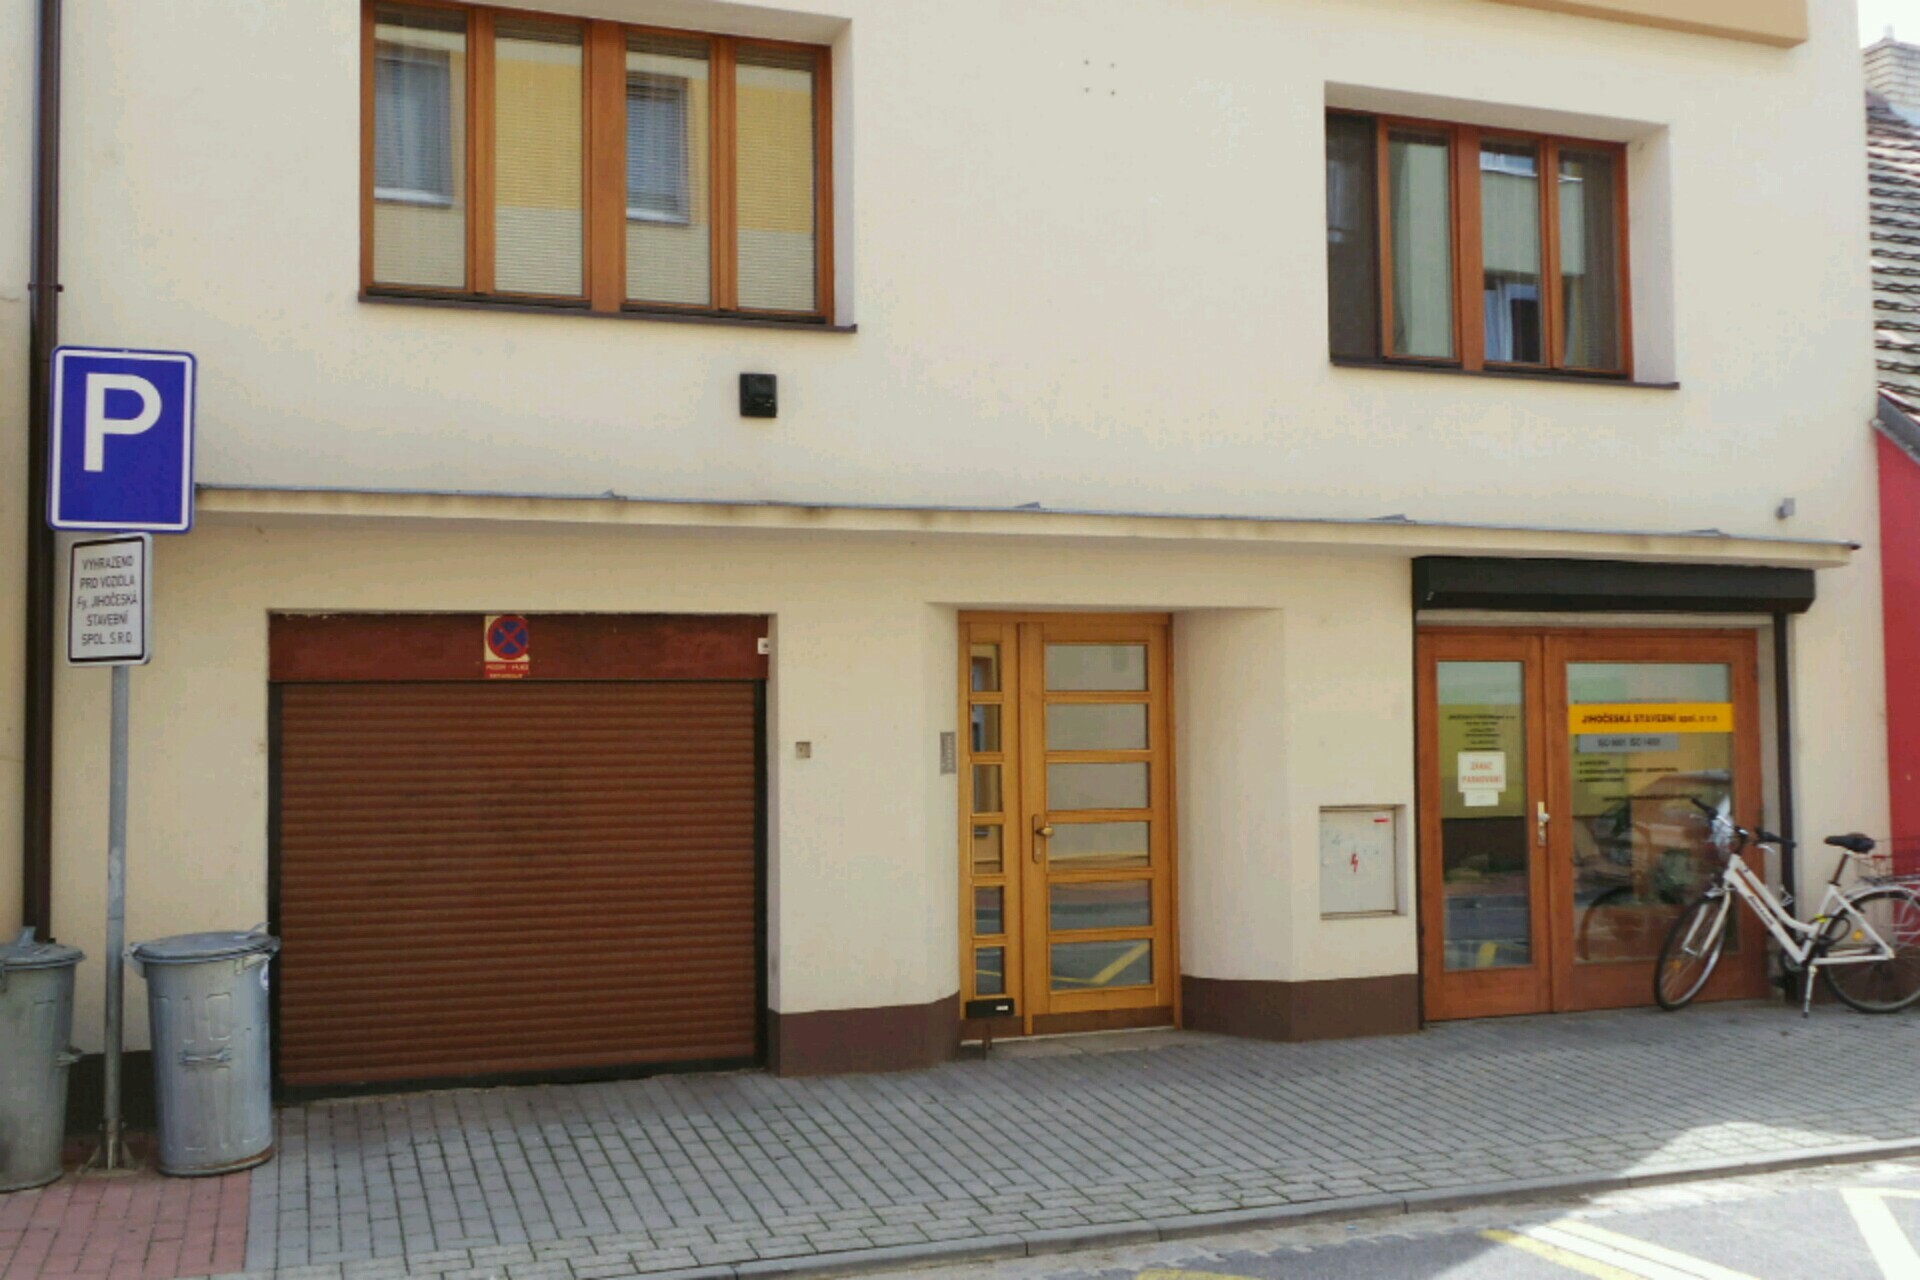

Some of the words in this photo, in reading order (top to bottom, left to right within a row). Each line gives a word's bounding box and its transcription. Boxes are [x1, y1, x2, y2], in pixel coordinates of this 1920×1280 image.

[84, 373, 162, 473] P
[82, 555, 134, 570] VYHRAZENO
[80, 577, 98, 589] PRO
[101, 574, 135, 588] VOZIDLA
[91, 590, 138, 608] JIHOČESKÁ
[86, 610, 128, 626] STAVEBNÍ
[1582, 712, 1631, 724] JIHOČESKÁ
[1634, 713, 1676, 723] STAVEBNÍ
